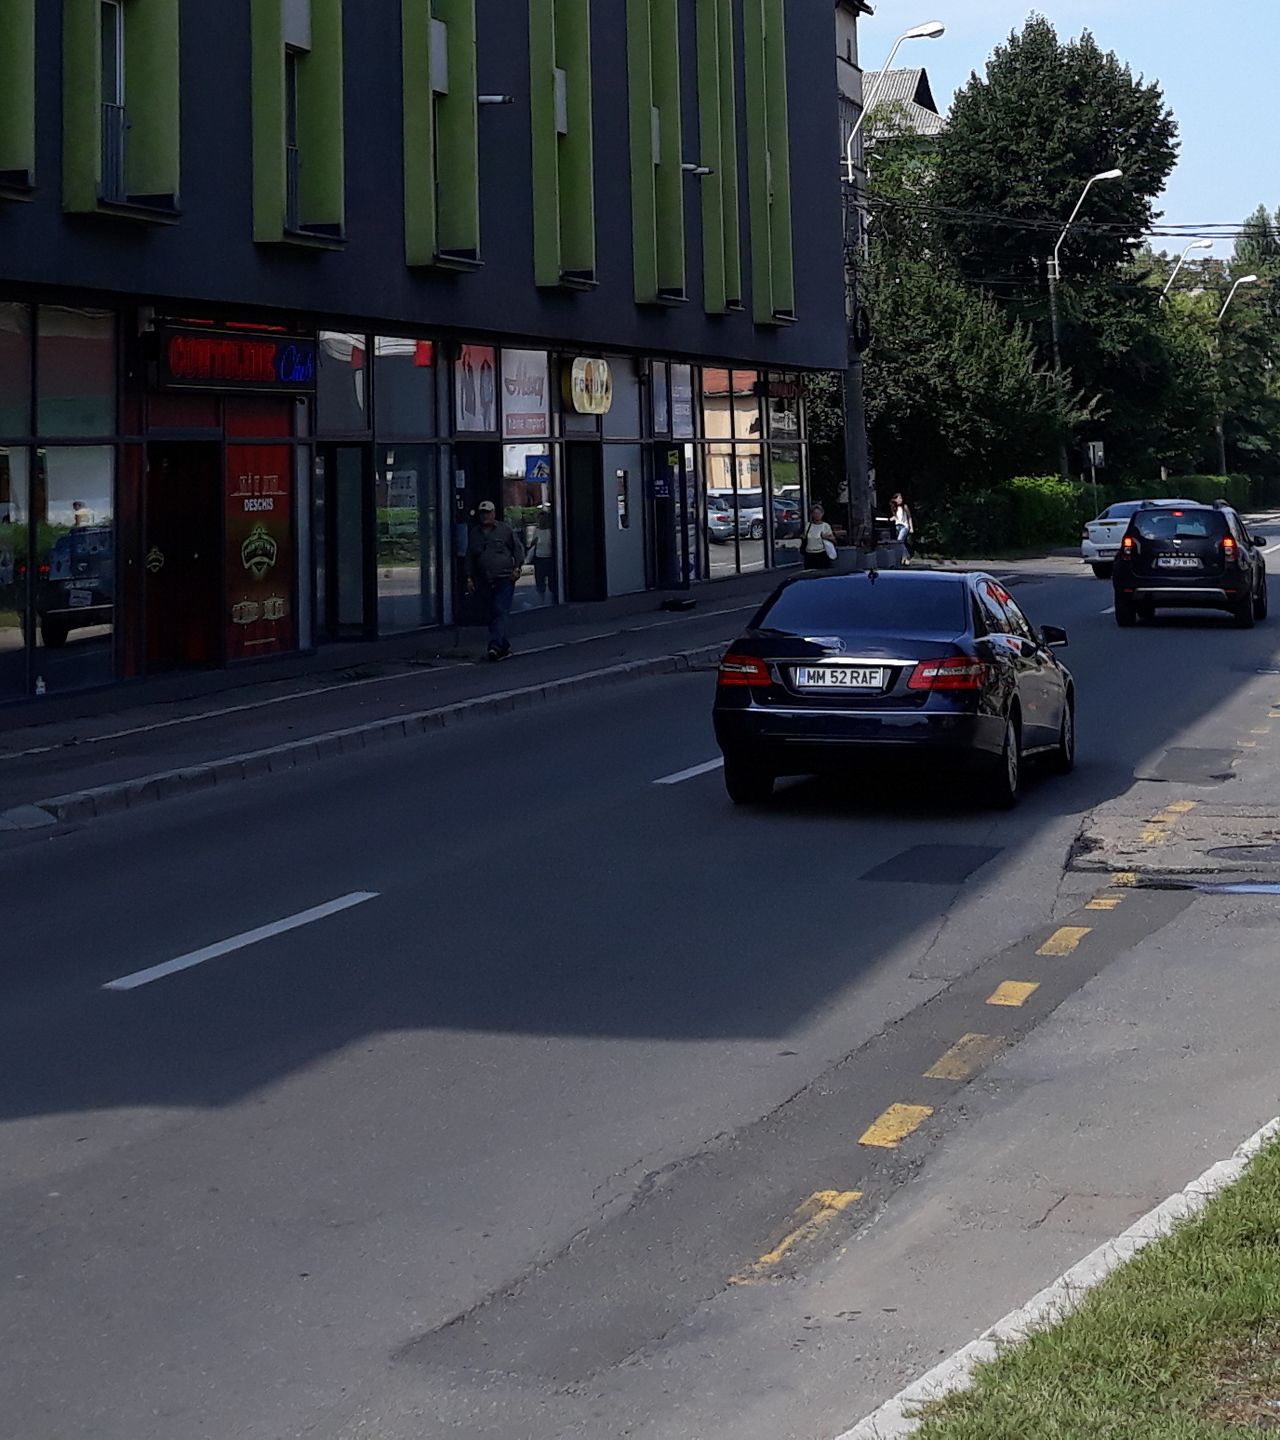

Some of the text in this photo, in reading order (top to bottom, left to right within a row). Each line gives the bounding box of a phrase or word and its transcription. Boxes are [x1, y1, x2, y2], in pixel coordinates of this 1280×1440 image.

[807, 670, 879, 685] MM 52 RAF
